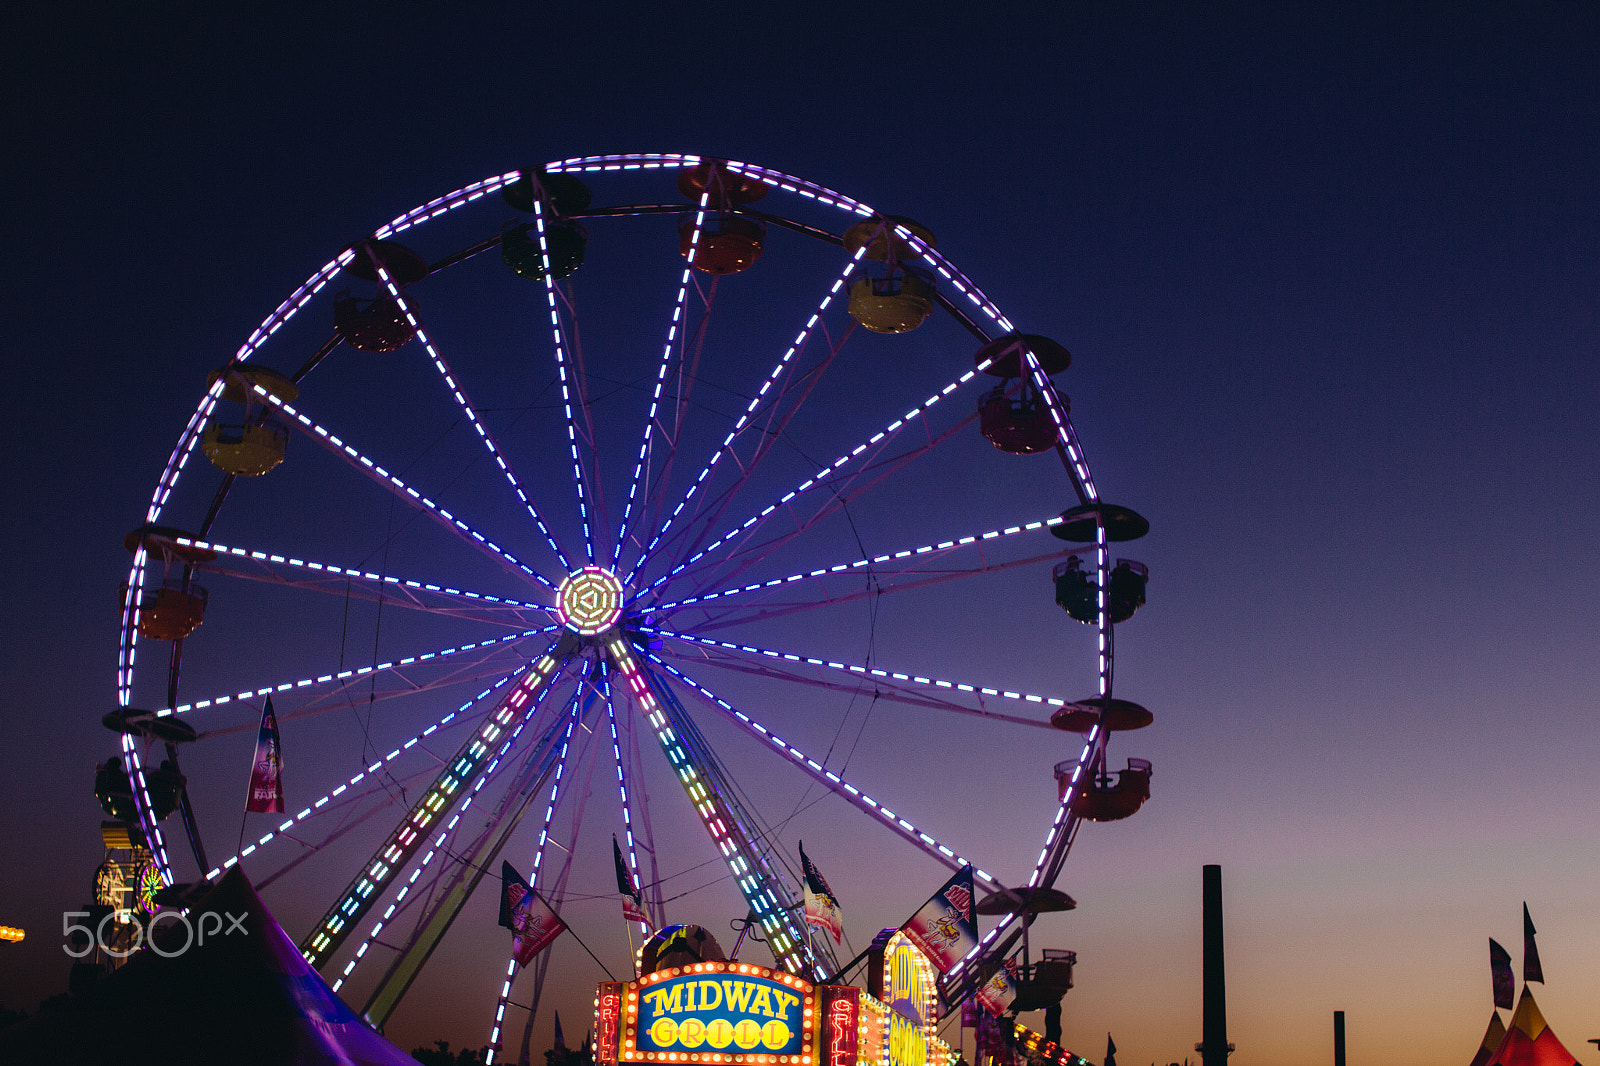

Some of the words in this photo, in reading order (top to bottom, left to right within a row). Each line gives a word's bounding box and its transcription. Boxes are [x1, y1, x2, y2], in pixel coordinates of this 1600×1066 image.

[644, 980, 799, 1020] MIDWAY
[602, 995, 613, 1061] GRILL
[652, 1019, 786, 1048] GRILL
